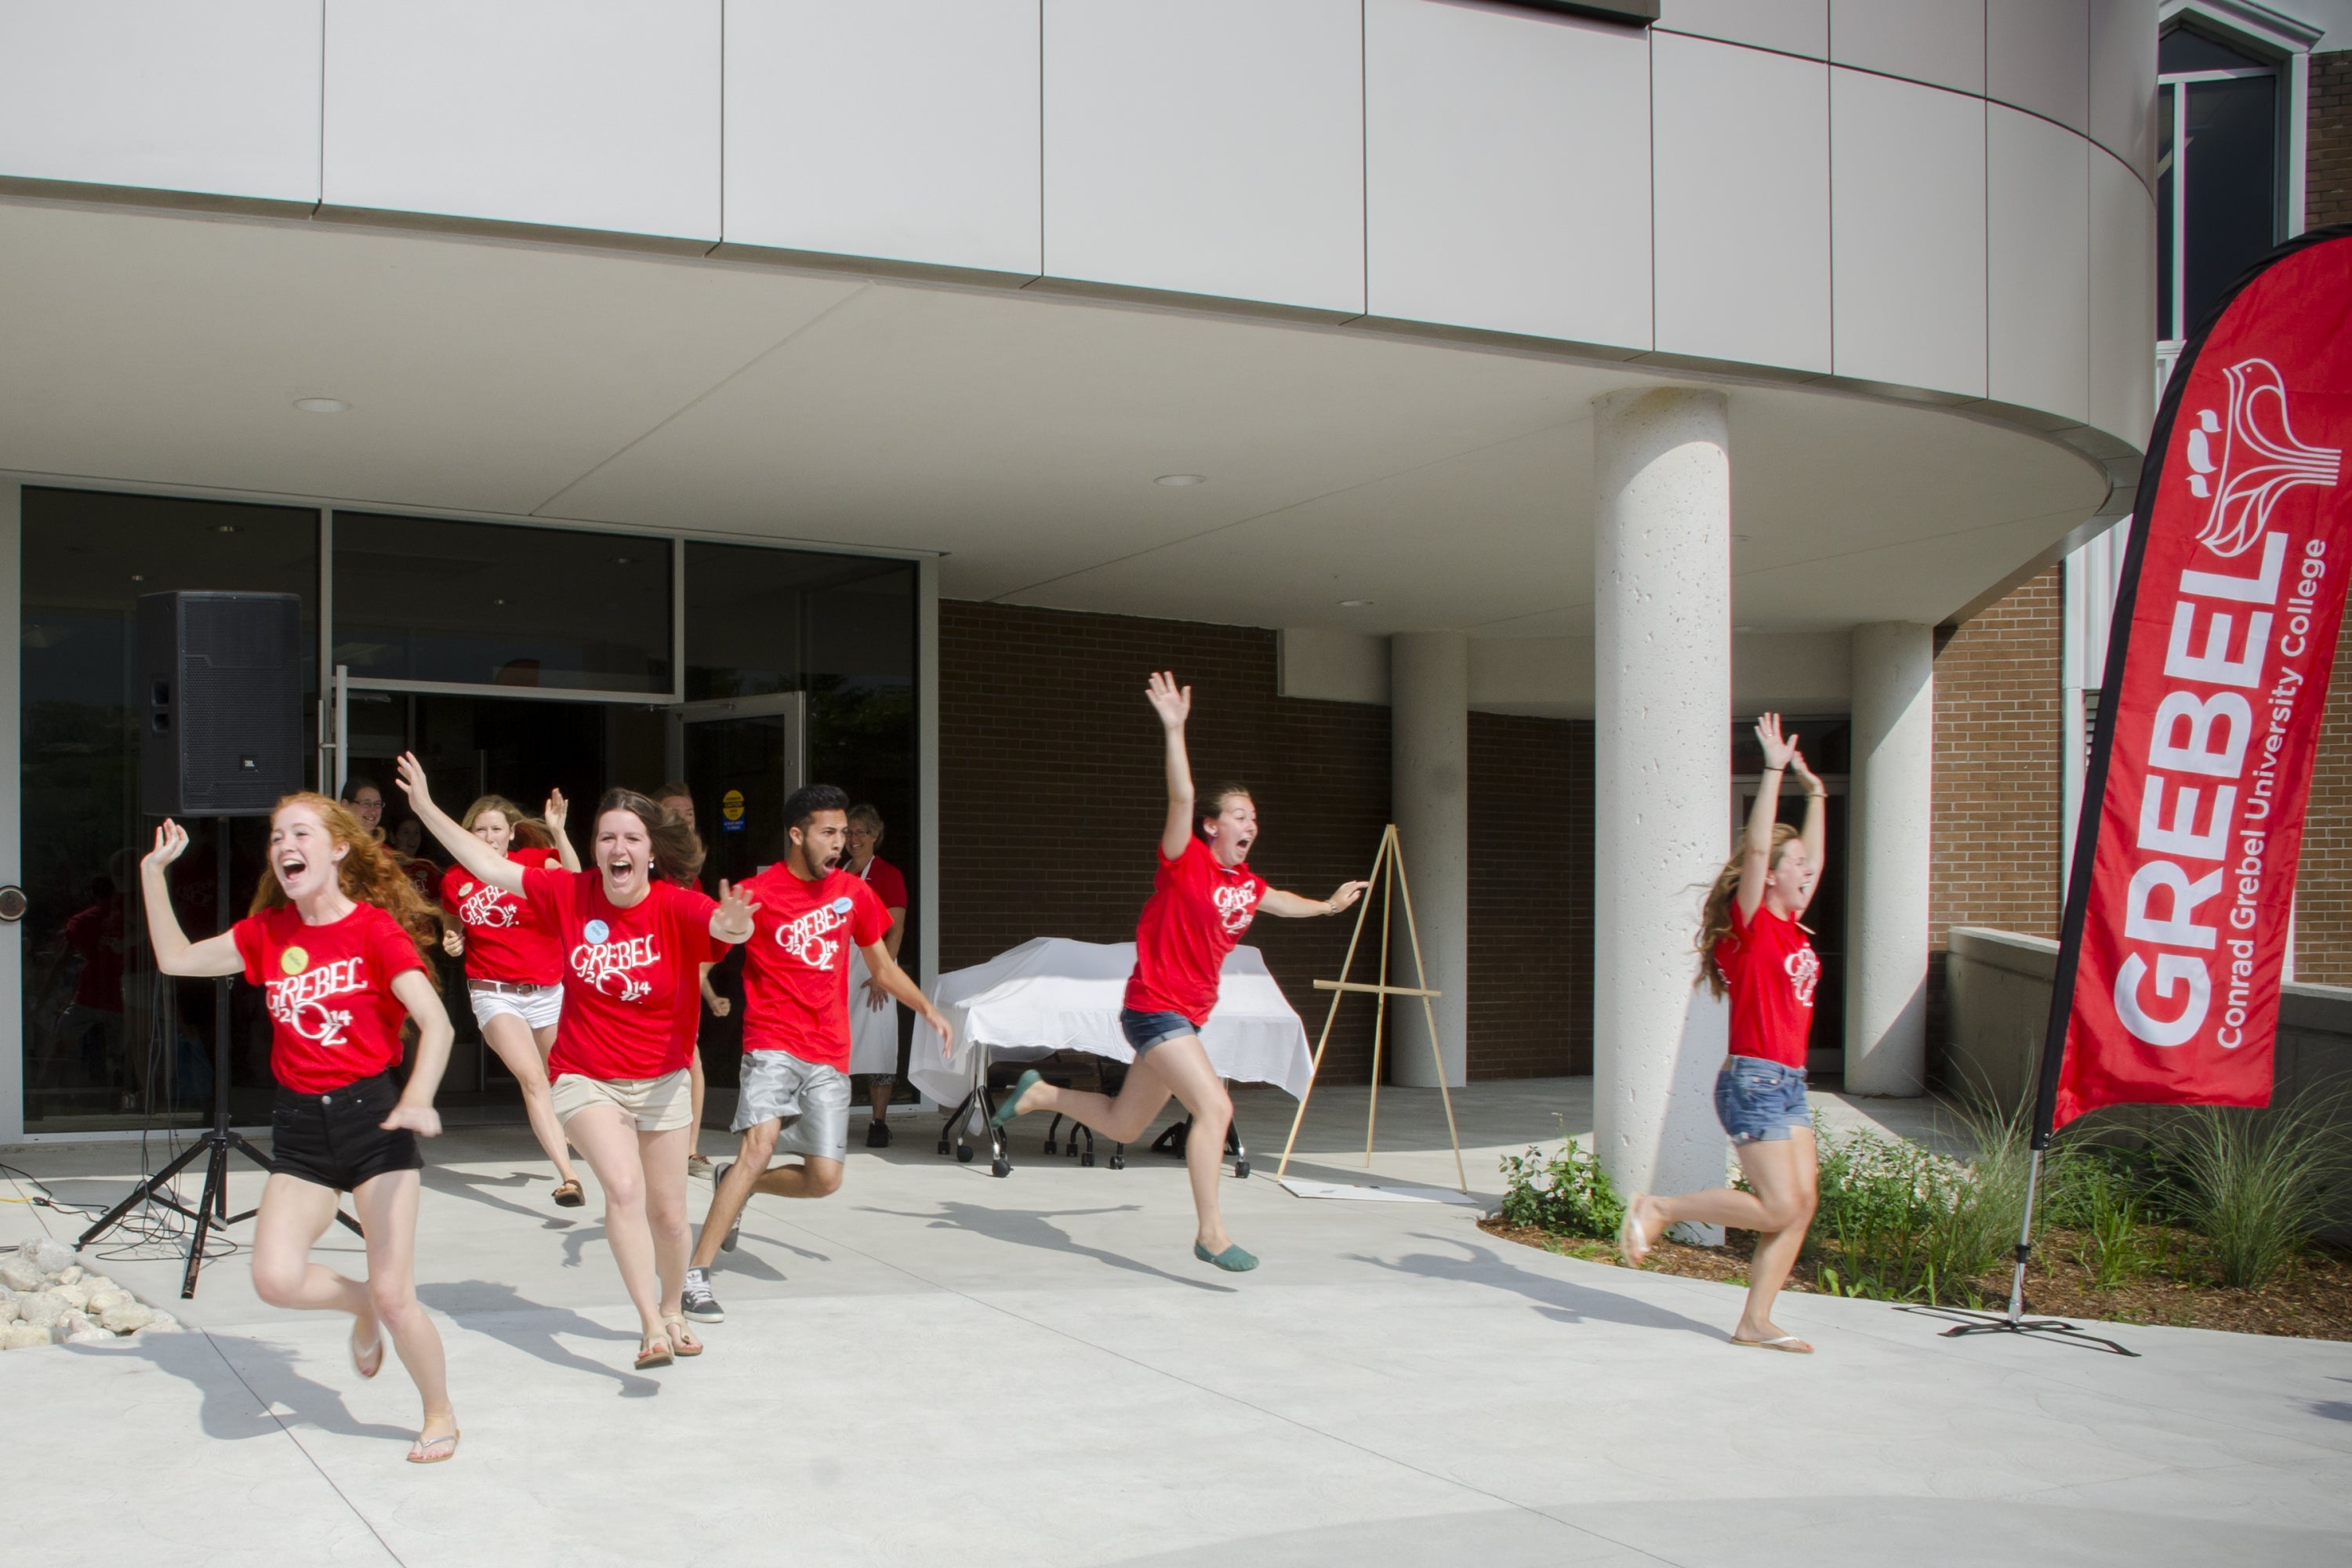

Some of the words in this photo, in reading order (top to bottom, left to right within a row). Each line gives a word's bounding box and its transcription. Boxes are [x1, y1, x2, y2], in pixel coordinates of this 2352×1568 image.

[2280, 539, 2326, 657] College
[2114, 531, 2288, 1047] GREBEL
[2244, 666, 2304, 820] University
[2230, 830, 2267, 930] Grebel
[264, 956, 368, 1018] GREBEL
[571, 933, 661, 978] GREBEL
[2217, 939, 2255, 1049] Conrad
